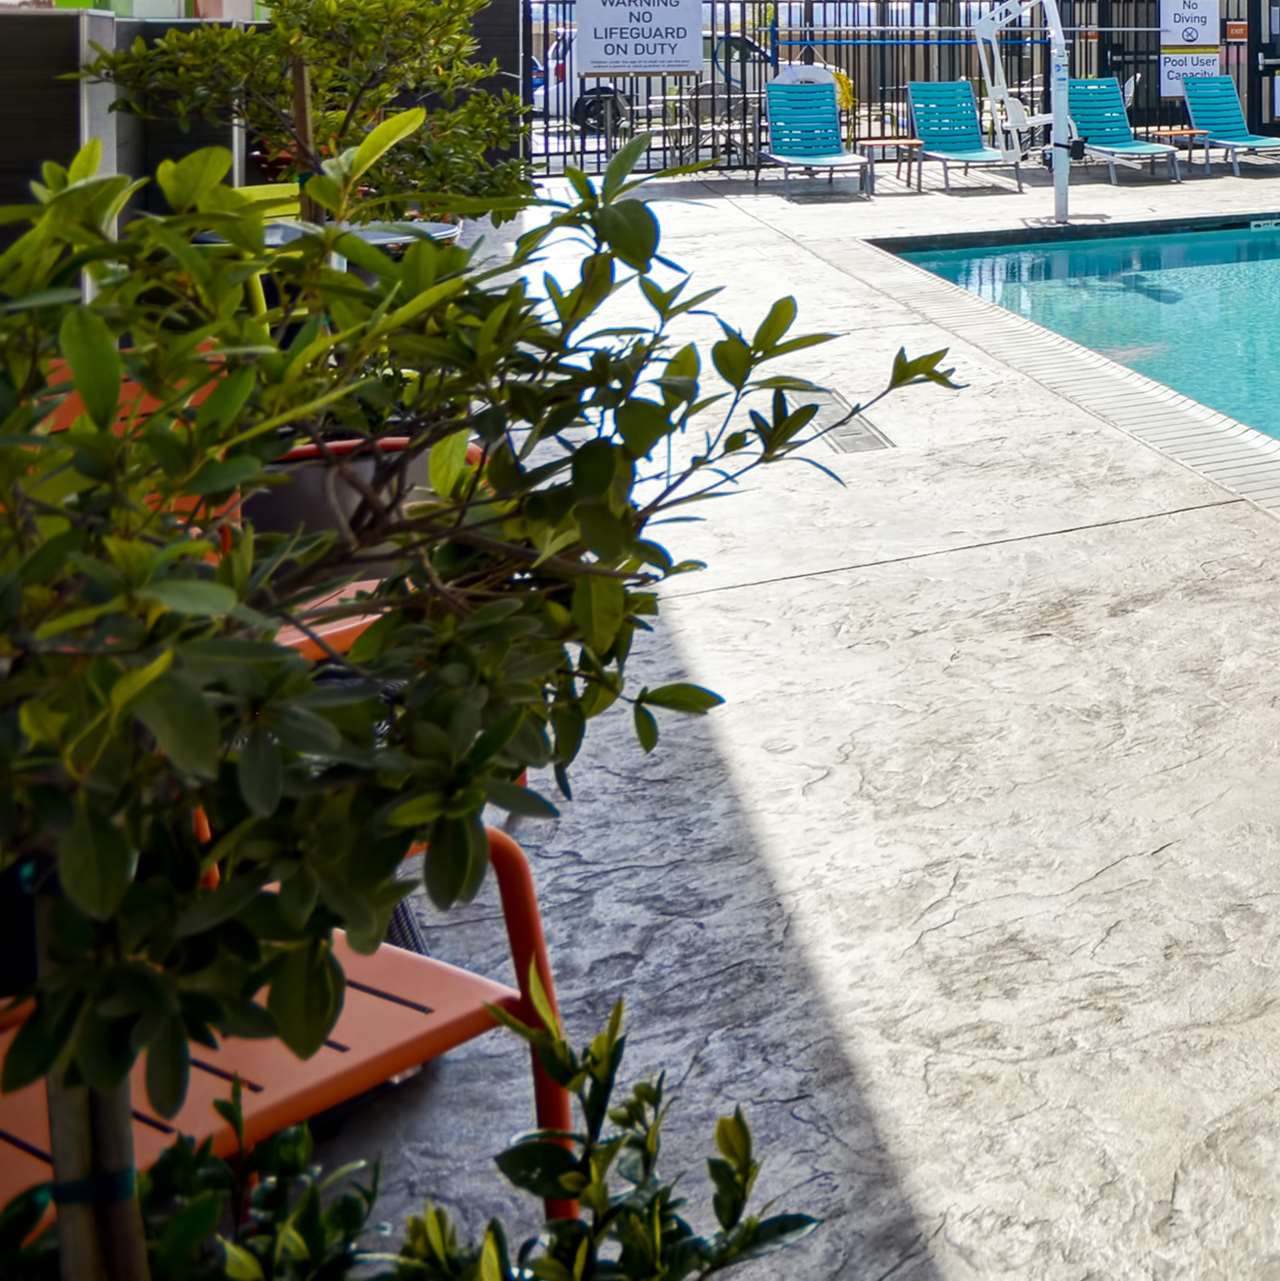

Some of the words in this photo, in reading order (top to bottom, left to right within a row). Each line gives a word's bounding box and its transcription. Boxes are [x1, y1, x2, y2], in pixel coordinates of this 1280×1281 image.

[1182, 0, 1199, 10] No
[628, 10, 653, 24] NO
[1173, 12, 1208, 26] Diving
[593, 26, 688, 40] LIFEGUARD
[603, 42, 629, 56] ON
[634, 42, 679, 56] DUTY
[1163, 56, 1188, 67] Pool
[1191, 56, 1217, 67] User
